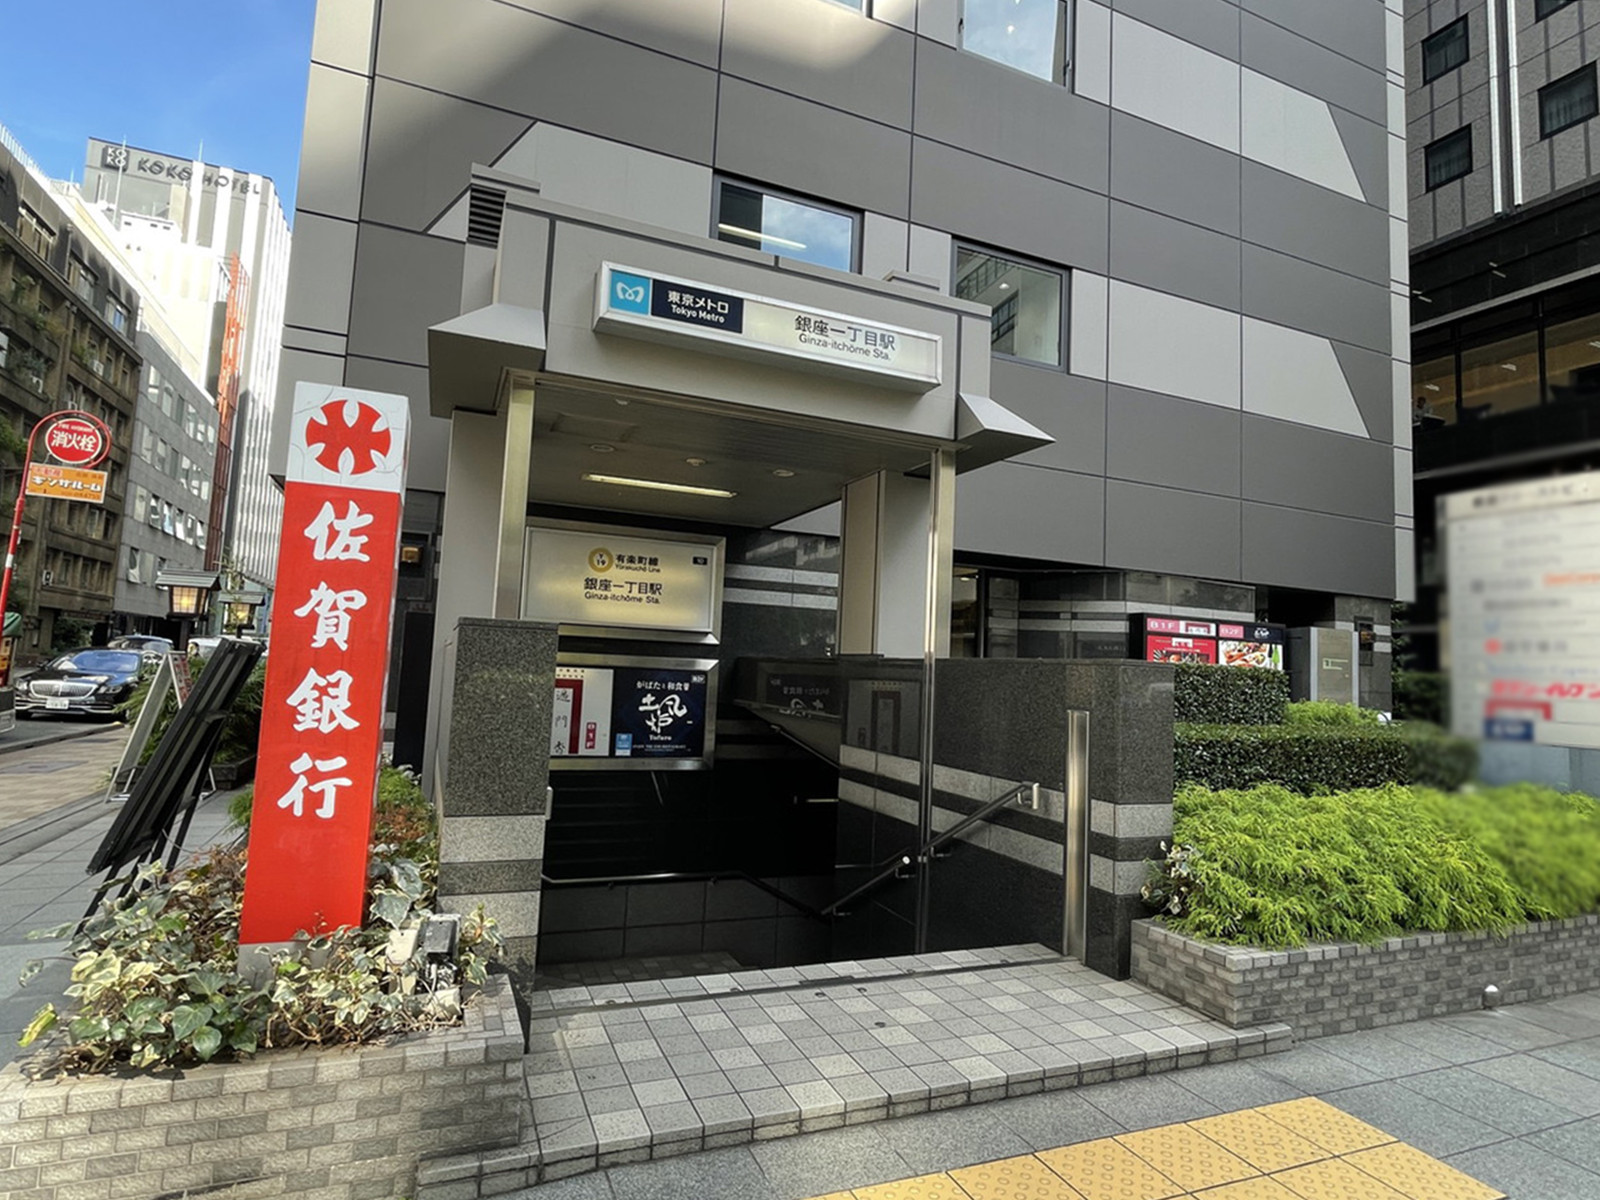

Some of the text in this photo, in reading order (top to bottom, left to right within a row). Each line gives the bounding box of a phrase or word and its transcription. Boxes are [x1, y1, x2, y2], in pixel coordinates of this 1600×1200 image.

[137, 156, 261, 195] KOKO HOTEL
[667, 290, 729, 314] 東京メトロ
[671, 305, 725, 323] Tokyo Metro
[794, 315, 896, 351] 銀座一丁目駅
[872, 347, 891, 361] Sta.
[51, 429, 97, 453] 消火栓
[615, 554, 659, 567] 有楽町線
[584, 577, 663, 596] 銀座一丁目駅
[646, 594, 661, 604] Sta.
[1150, 620, 1175, 629] B1F
[277, 500, 374, 819] 佐賀銀行
